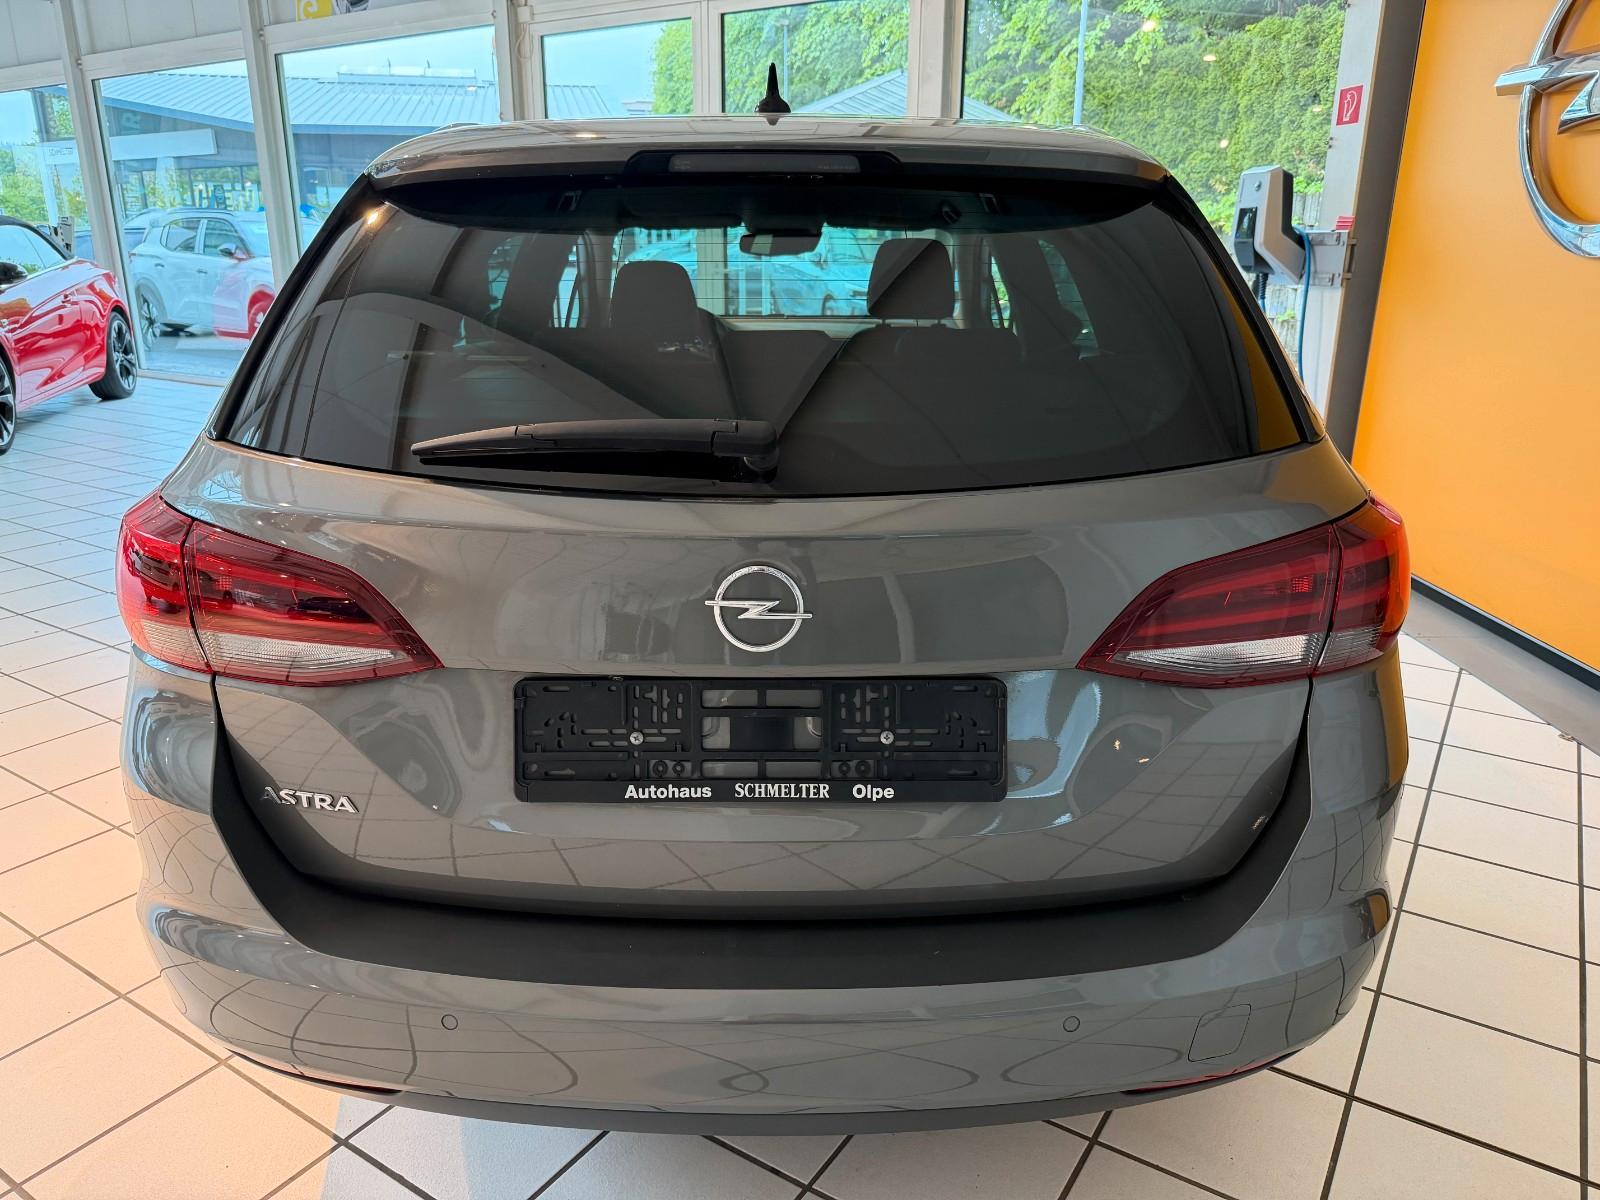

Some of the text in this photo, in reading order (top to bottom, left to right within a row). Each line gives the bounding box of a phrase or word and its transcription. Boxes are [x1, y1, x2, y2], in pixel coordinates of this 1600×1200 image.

[261, 786, 359, 813] ASTRA
[624, 782, 895, 802] Autohaus SCHMELTER Olpe
